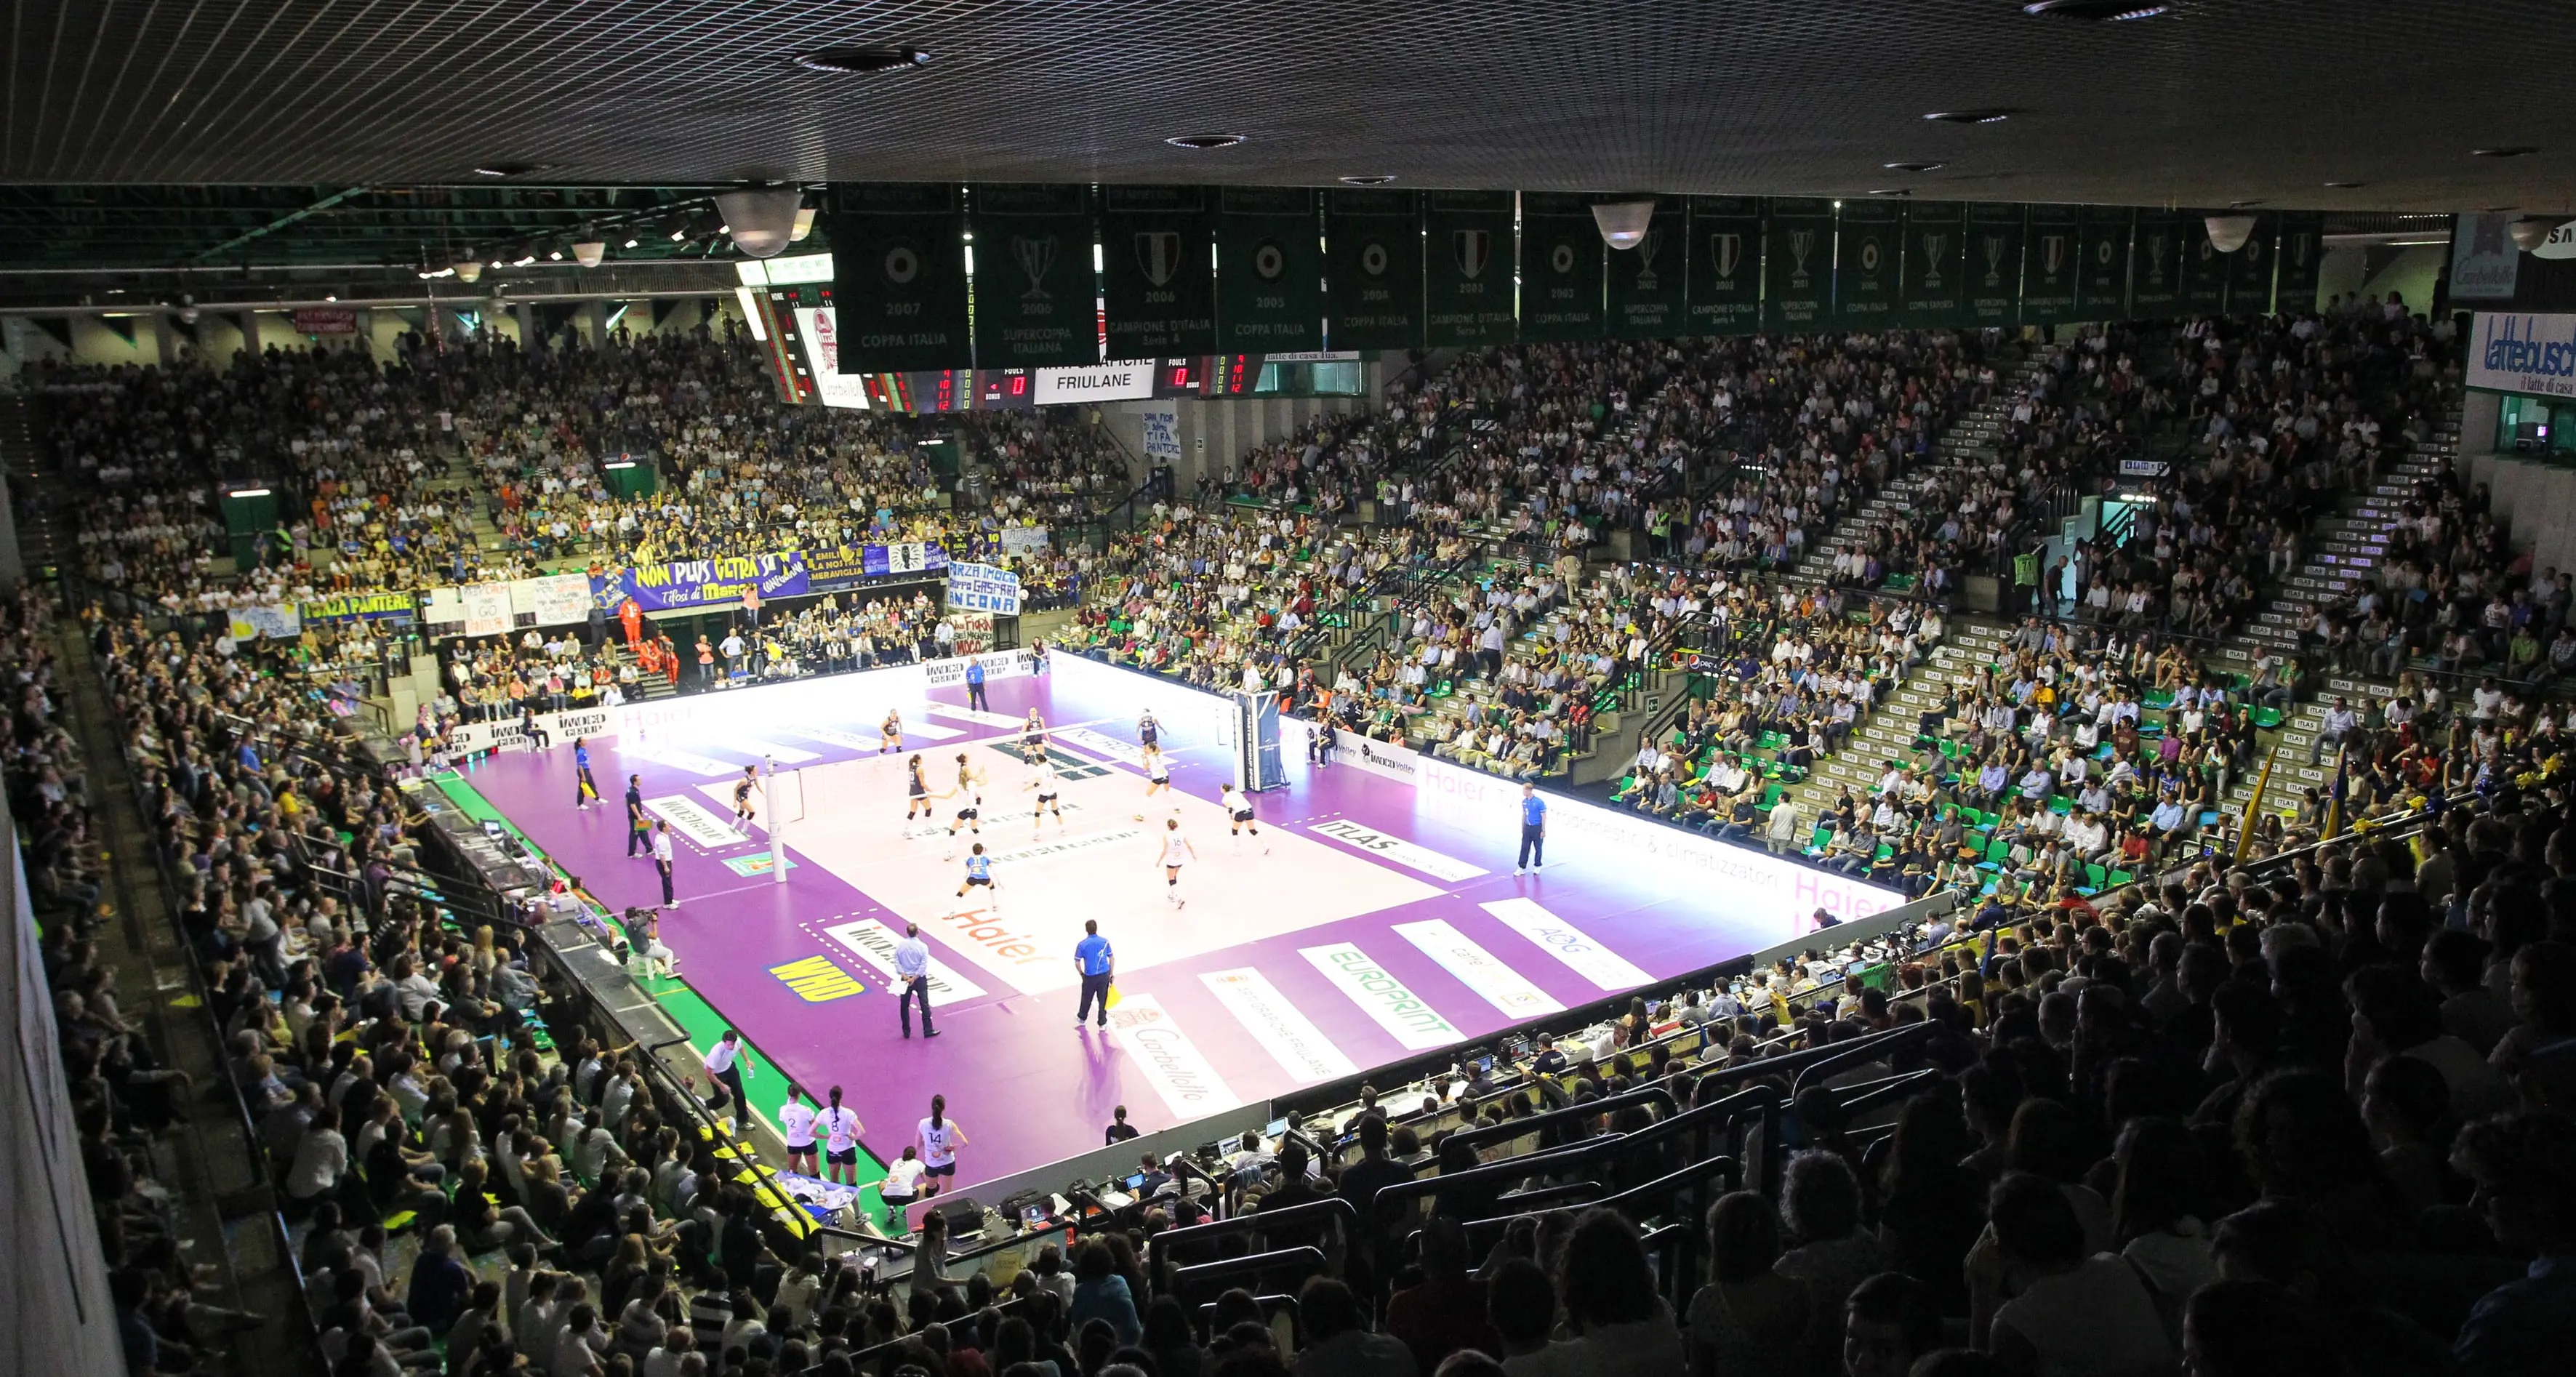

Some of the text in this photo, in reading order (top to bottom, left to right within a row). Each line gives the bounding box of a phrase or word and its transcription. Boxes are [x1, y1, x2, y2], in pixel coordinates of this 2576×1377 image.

[1145, 292, 1176, 303] 2006
[1256, 297, 1285, 309] 2005
[886, 302, 922, 315] 2007
[1624, 304, 1669, 315] SUPERCOPPA
[1692, 305, 1728, 316] CAMPIONE
[1345, 315, 1408, 328] COPPA ITALIA
[1430, 311, 1512, 325] CAMPIONE D'ITALIA
[1535, 311, 1590, 324] COPPA ITALIA
[1629, 315, 1662, 326] ITALIANA
[1110, 320, 1211, 334] CAMPIONE D'ITALIA
[1235, 323, 1305, 336] COPPA ITALIA
[862, 332, 947, 348] COPPA ITALIA
[1003, 327, 1072, 341] SUPERCOPPA
[1013, 342, 1062, 354] ITALIANA
[939, 380, 950, 389] 10
[1057, 374, 1131, 389] FRIULANE
[2527, 375, 2545, 393] latte
[2546, 377, 2555, 393] di
[2555, 381, 2573, 394] casa
[939, 390, 950, 400] 11
[937, 401, 949, 411] 12
[635, 556, 760, 587] NON PLUS ULTRA
[812, 559, 862, 571] LA NOSTRA
[811, 569, 864, 581] MERAVIGLIA
[983, 567, 1017, 584] IMOCO
[973, 579, 1017, 598] GASPARI
[662, 585, 701, 606] Tifosi di
[949, 590, 1014, 612] ANCONA
[350, 592, 411, 614] PANTERE
[478, 605, 497, 617] GO
[2228, 650, 2244, 659] ITLAS
[931, 673, 961, 684] GROUP
[2372, 686, 2391, 695] ITLAS
[565, 725, 602, 736] GROUP
[2286, 734, 2303, 742] ITLAS
[1338, 743, 1357, 757] Volley
[1395, 760, 1416, 776] Volley
[2302, 770, 2319, 779] ITLAS
[1425, 763, 1486, 802] Haier
[1317, 822, 1400, 850] ITLAS
[1172, 838, 1182, 848] 16
[1647, 835, 1779, 889] & climatizzatori
[943, 909, 1058, 965] Haier
[1329, 951, 1453, 1035] EUROPRINT
[1289, 1037, 1332, 1077] FRIULANE
[1135, 1027, 1203, 1101] Garbellotto
[788, 1117, 796, 1128] 2
[928, 1132, 943, 1144] 14
